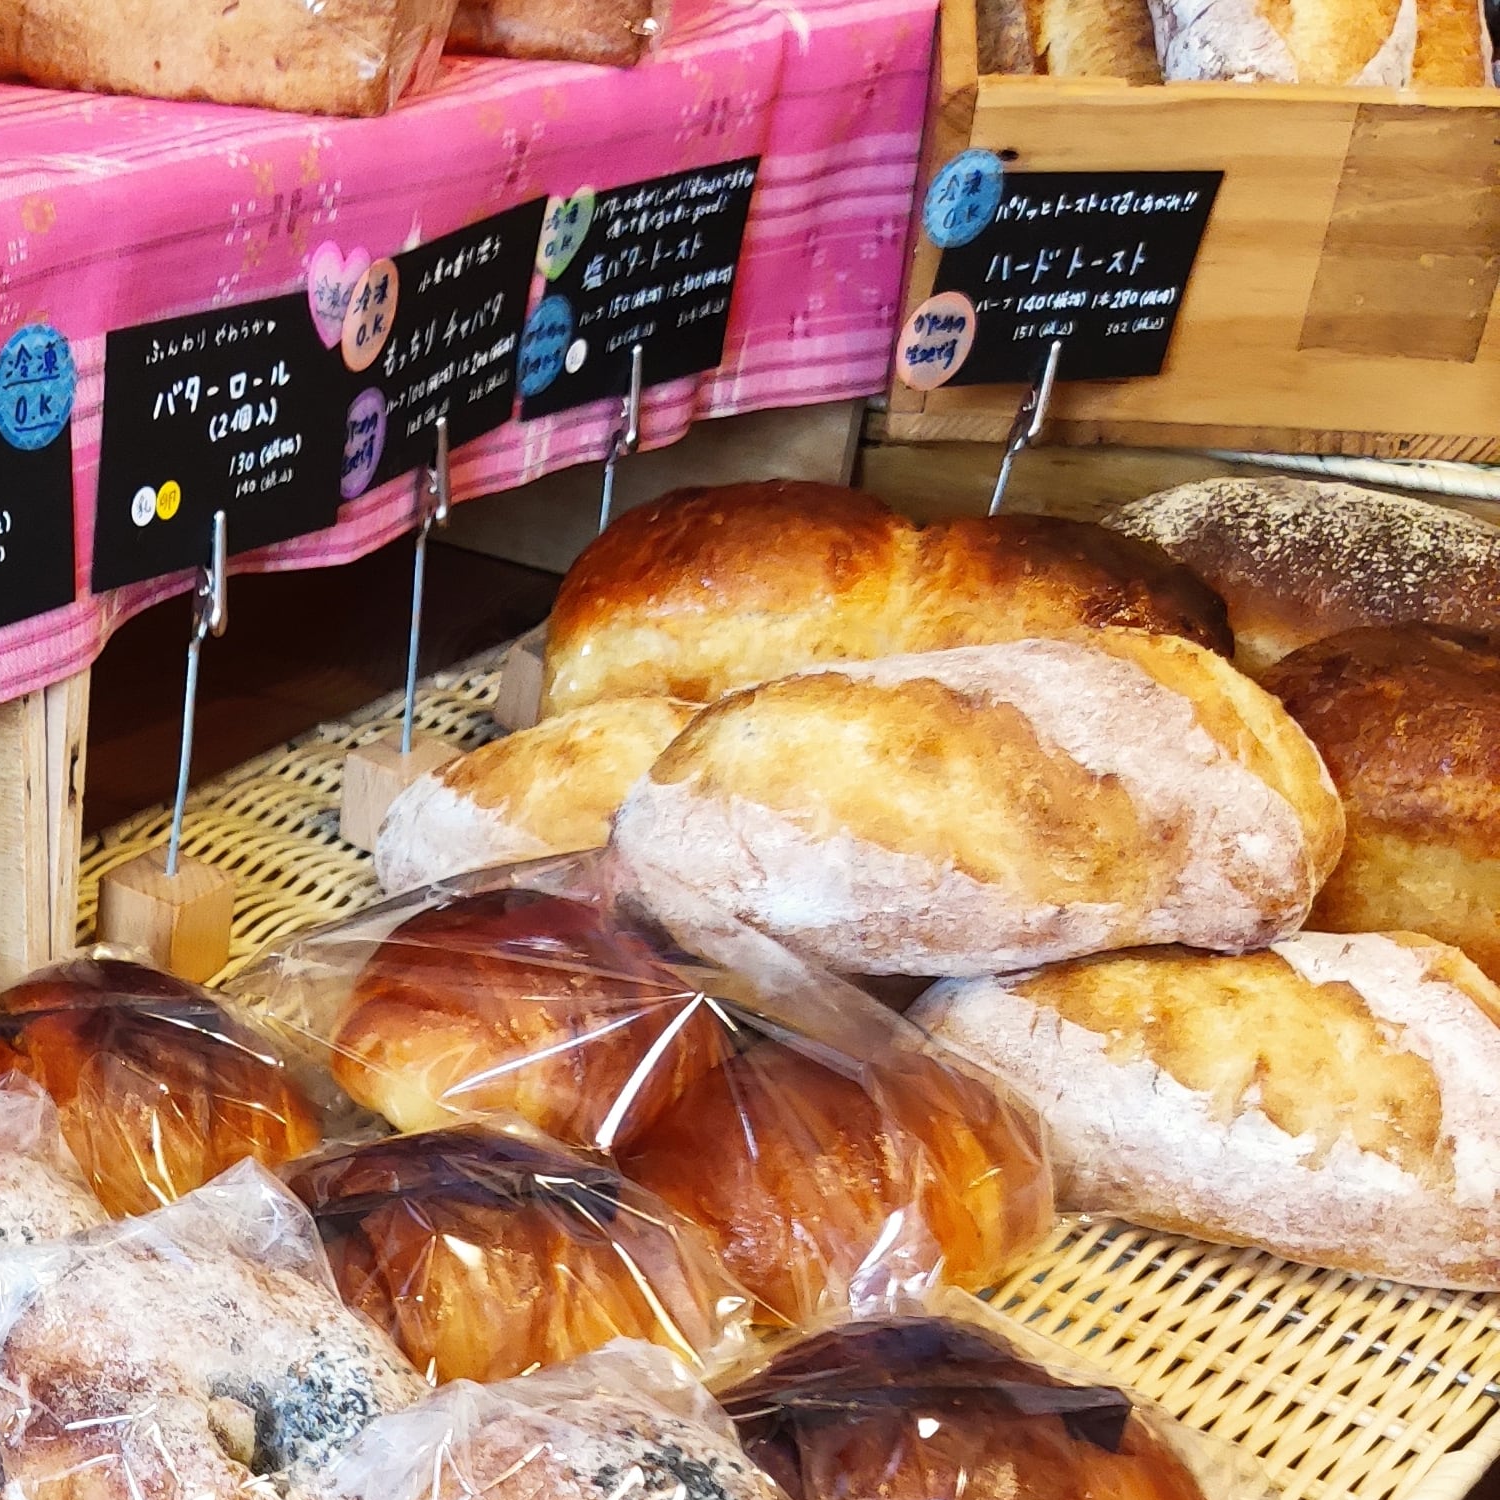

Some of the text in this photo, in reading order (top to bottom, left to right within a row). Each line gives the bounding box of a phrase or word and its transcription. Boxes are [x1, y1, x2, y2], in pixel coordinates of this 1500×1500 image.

[985, 242, 1147, 284] ハードトースト
[5, 341, 60, 378] 冷凍
[153, 360, 291, 420] バターロール
